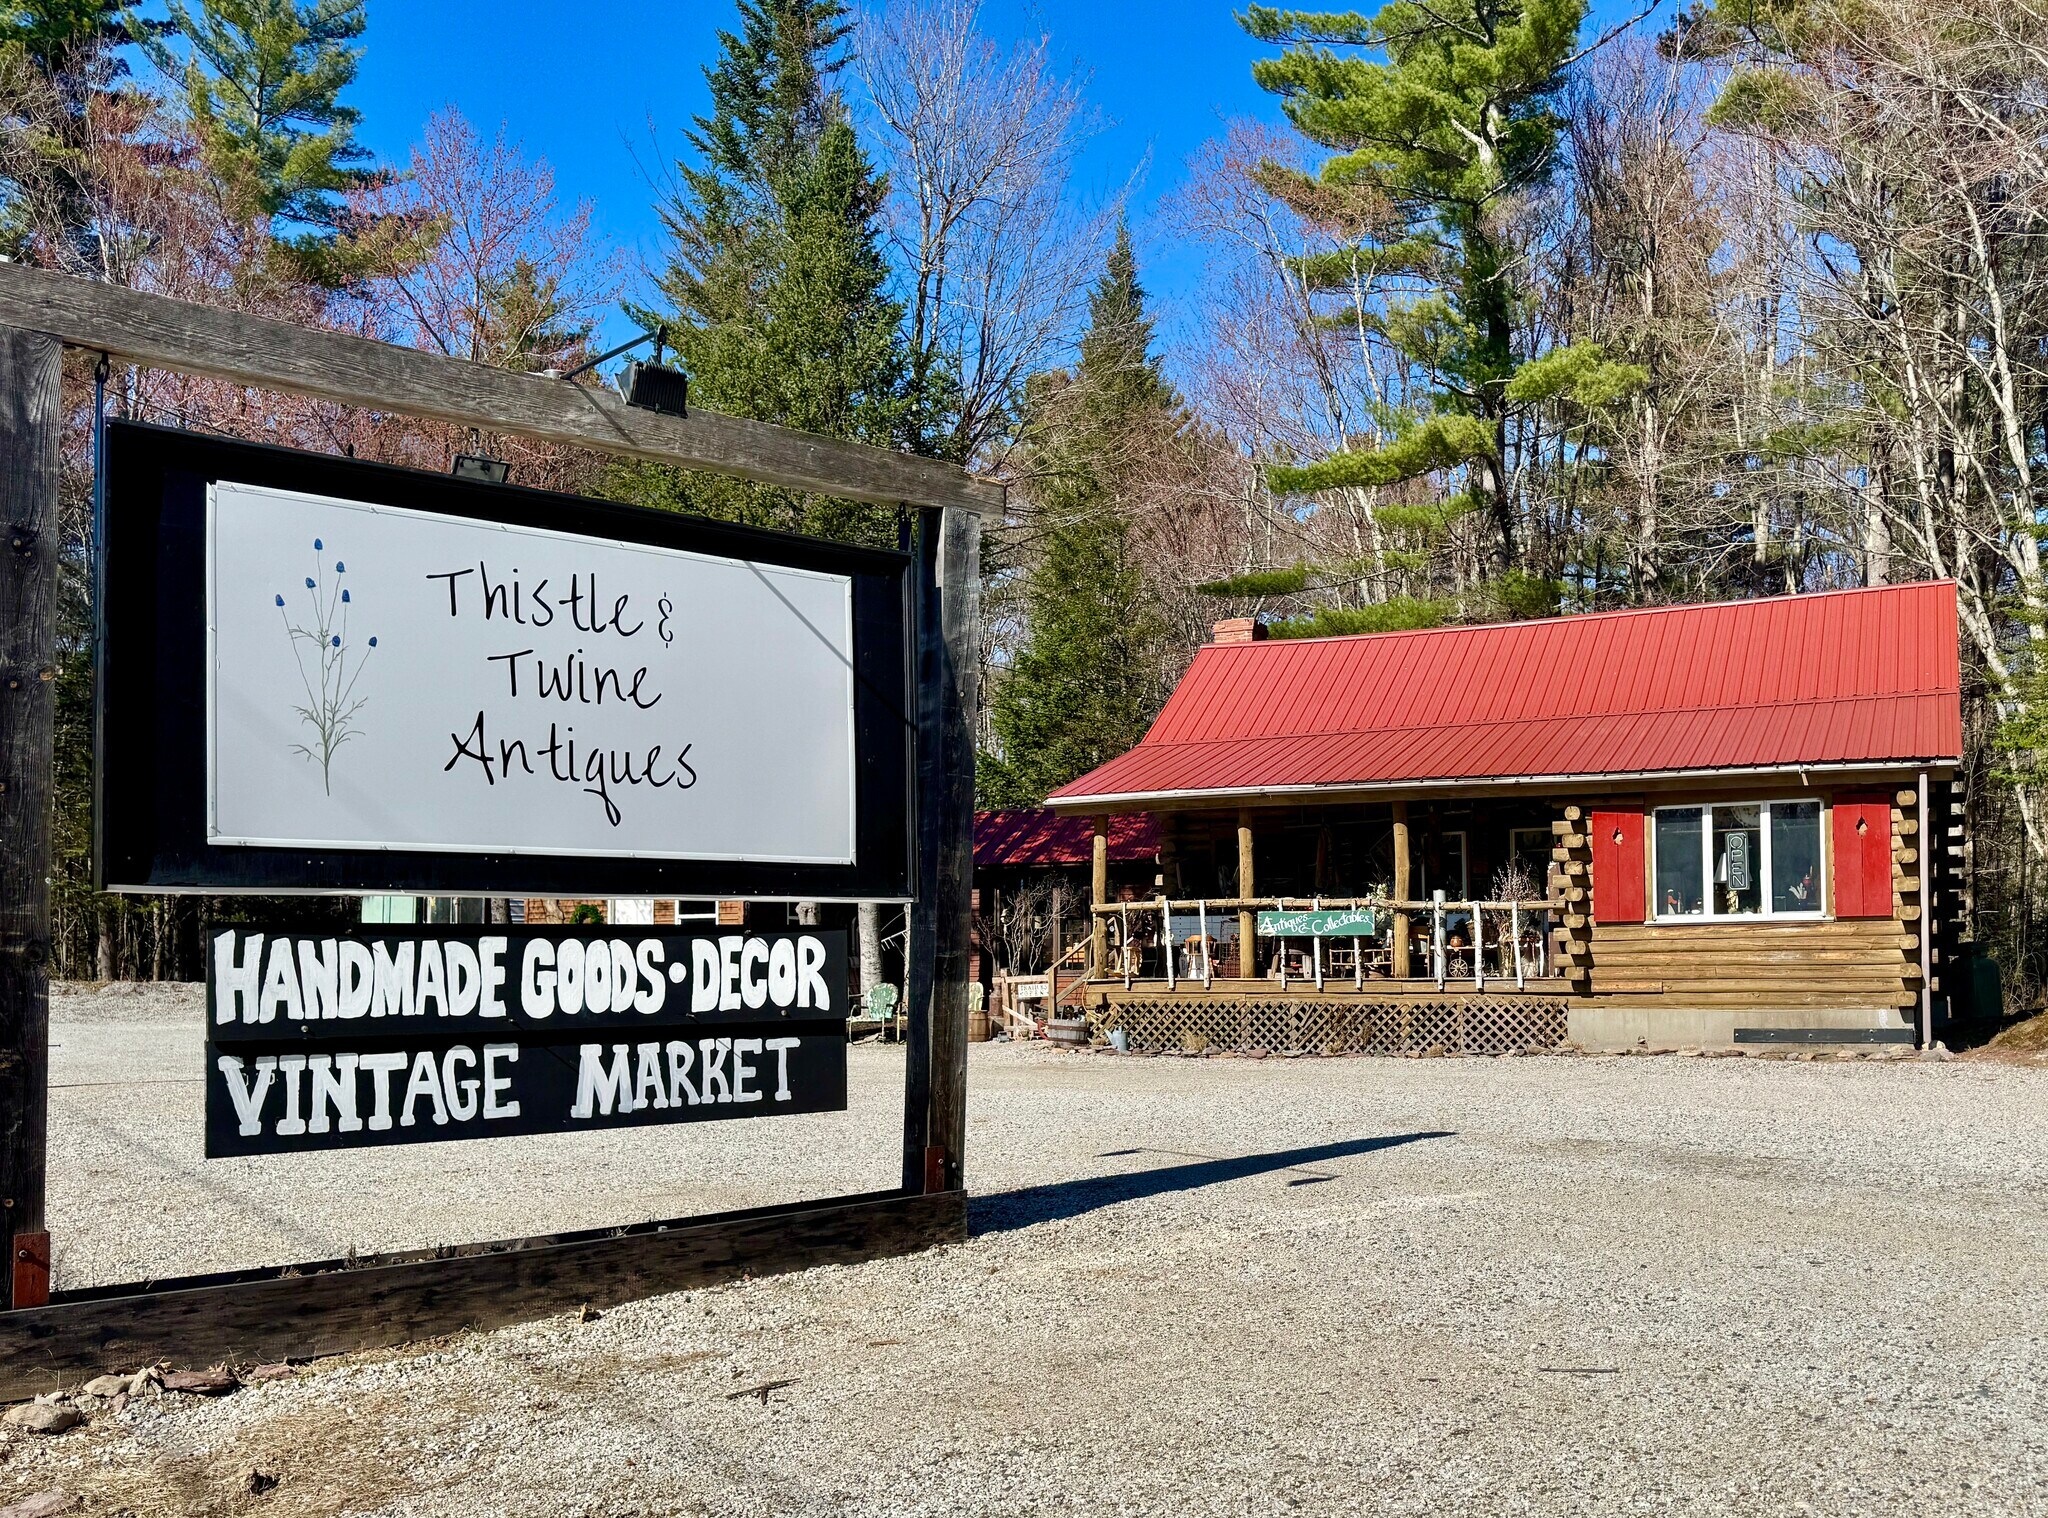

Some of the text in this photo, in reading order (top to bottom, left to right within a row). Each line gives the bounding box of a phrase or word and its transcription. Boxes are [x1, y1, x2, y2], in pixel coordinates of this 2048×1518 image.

[426, 561, 673, 648] Thistle &
[487, 650, 661, 709] Twine
[445, 711, 696, 826] Antiques
[1730, 836, 1743, 887] OPEN
[1260, 914, 1308, 935] Antiques
[214, 929, 507, 1025] HANDMADE
[218, 1037, 800, 1136] VINTAGE MARKET
